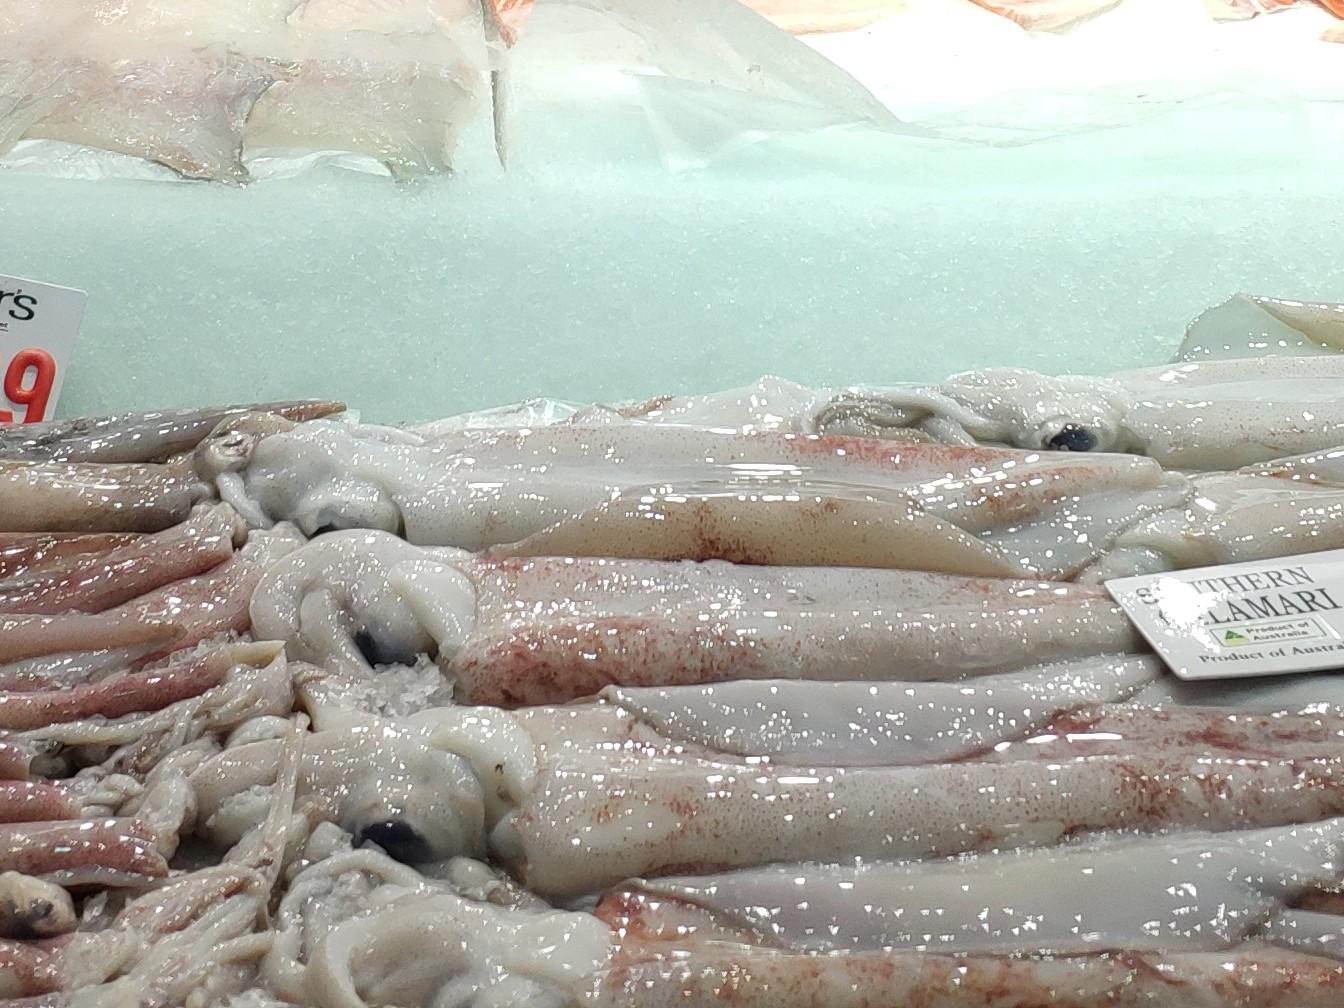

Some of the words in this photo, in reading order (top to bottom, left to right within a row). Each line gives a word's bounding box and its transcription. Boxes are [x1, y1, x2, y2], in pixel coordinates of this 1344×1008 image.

[1135, 566, 1316, 606] STHERN
[1199, 651, 1264, 665] Product
[1269, 647, 1286, 658] of
